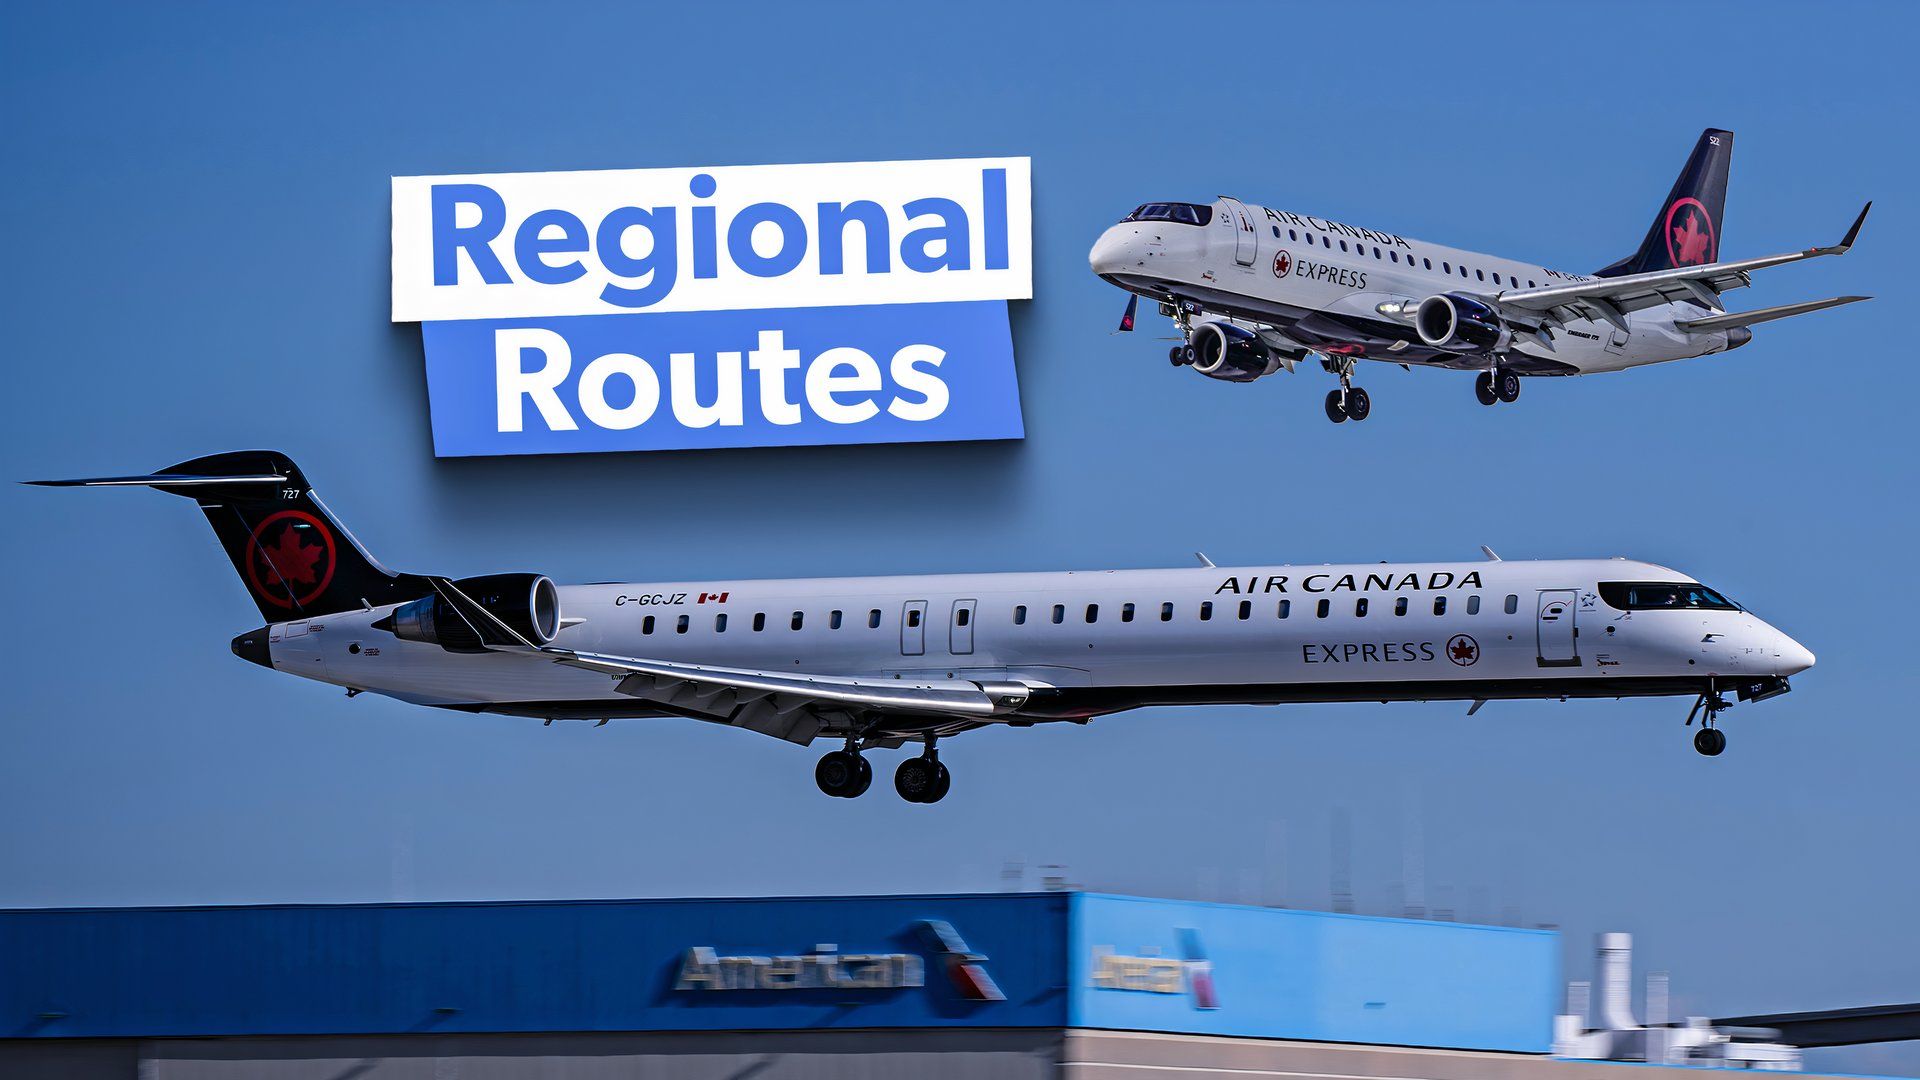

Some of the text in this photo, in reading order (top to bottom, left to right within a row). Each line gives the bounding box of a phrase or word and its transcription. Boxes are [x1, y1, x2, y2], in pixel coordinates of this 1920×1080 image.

[1263, 207, 1412, 250] AIR CANADA
[1296, 260, 1368, 290] EXPRESS
[282, 489, 300, 499] 727
[1215, 571, 1483, 595] AIR CANADA
[615, 593, 688, 606] C-GCJZ
[1302, 641, 1435, 664] EXPRESS
